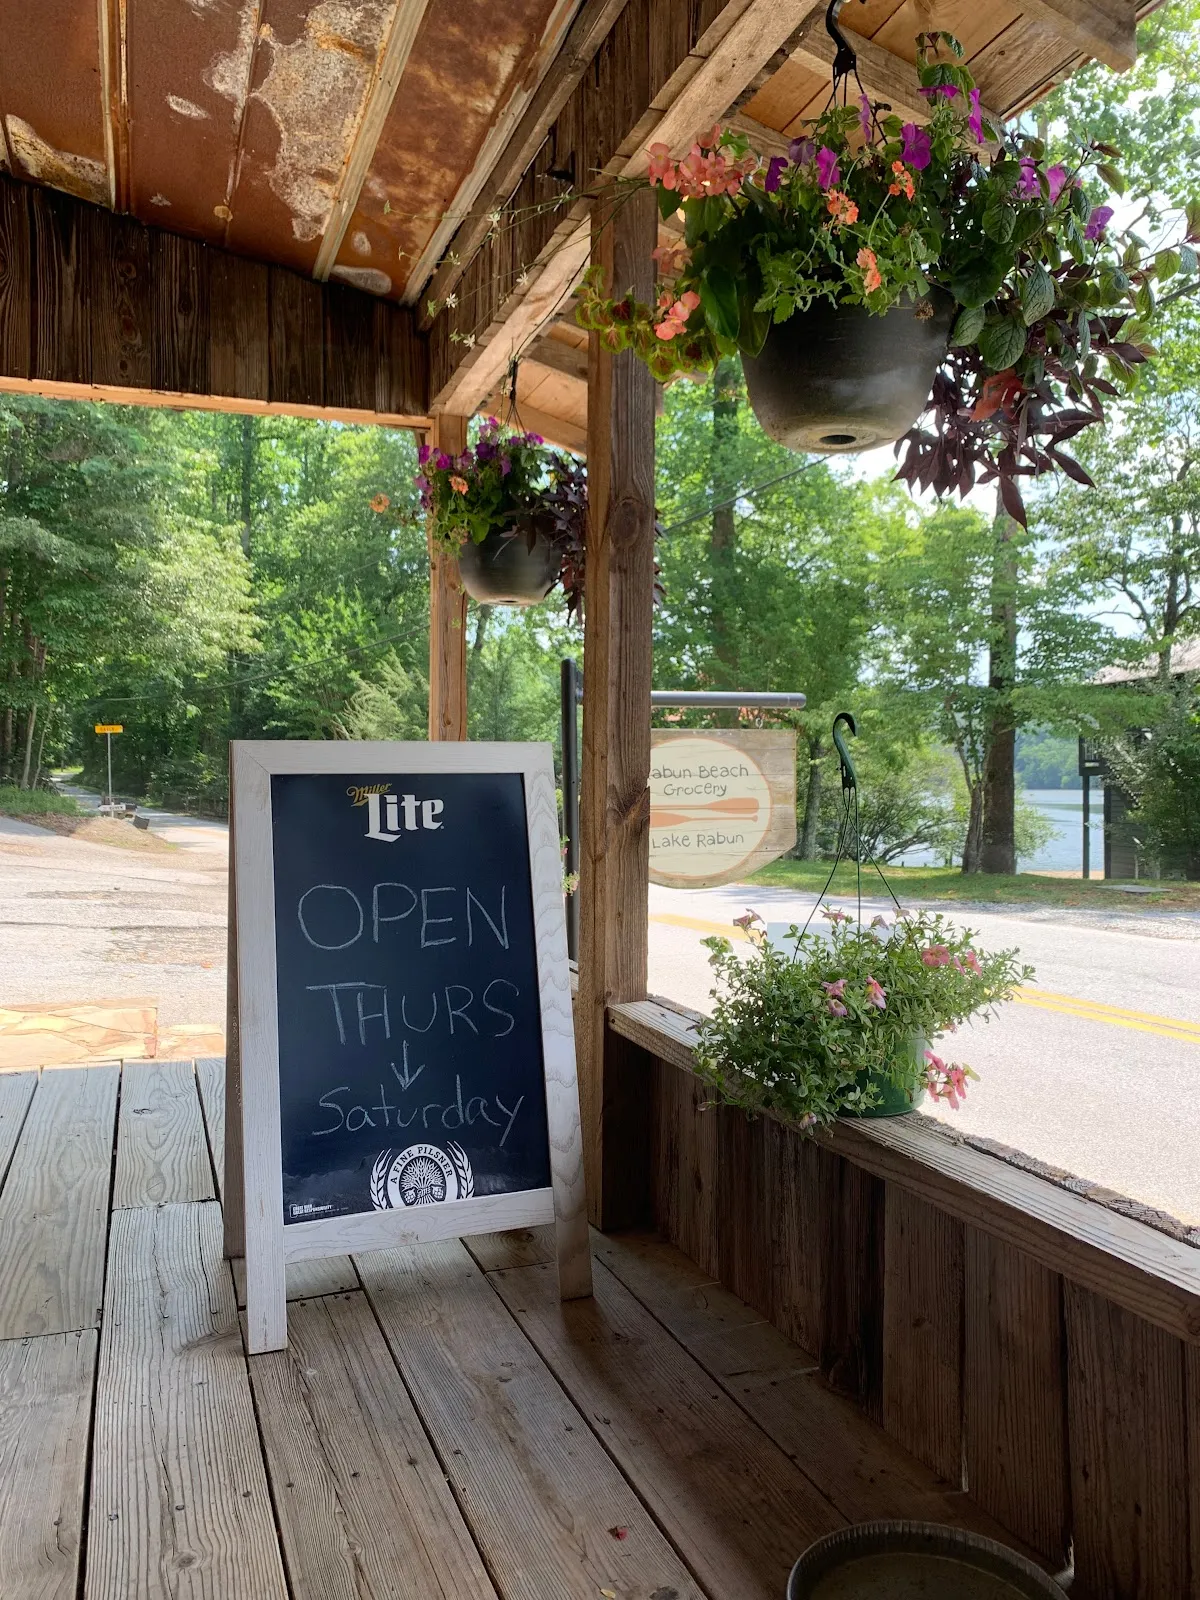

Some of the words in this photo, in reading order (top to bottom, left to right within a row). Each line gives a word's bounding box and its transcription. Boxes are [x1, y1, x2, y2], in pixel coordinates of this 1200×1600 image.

[652, 764, 692, 779] abun
[698, 764, 749, 779] Beach
[346, 783, 392, 807] Miller
[663, 782, 727, 797] Grocery
[363, 793, 444, 843] Lite
[652, 832, 691, 849] Lake
[696, 831, 744, 848] Rabun
[297, 881, 509, 951] OPEN
[305, 978, 520, 1046] THURS
[311, 1074, 525, 1147] Saturday
[393, 1149, 414, 1174] FINE
[417, 1146, 453, 1178] PILSNER
[390, 1176, 398, 1185] A
